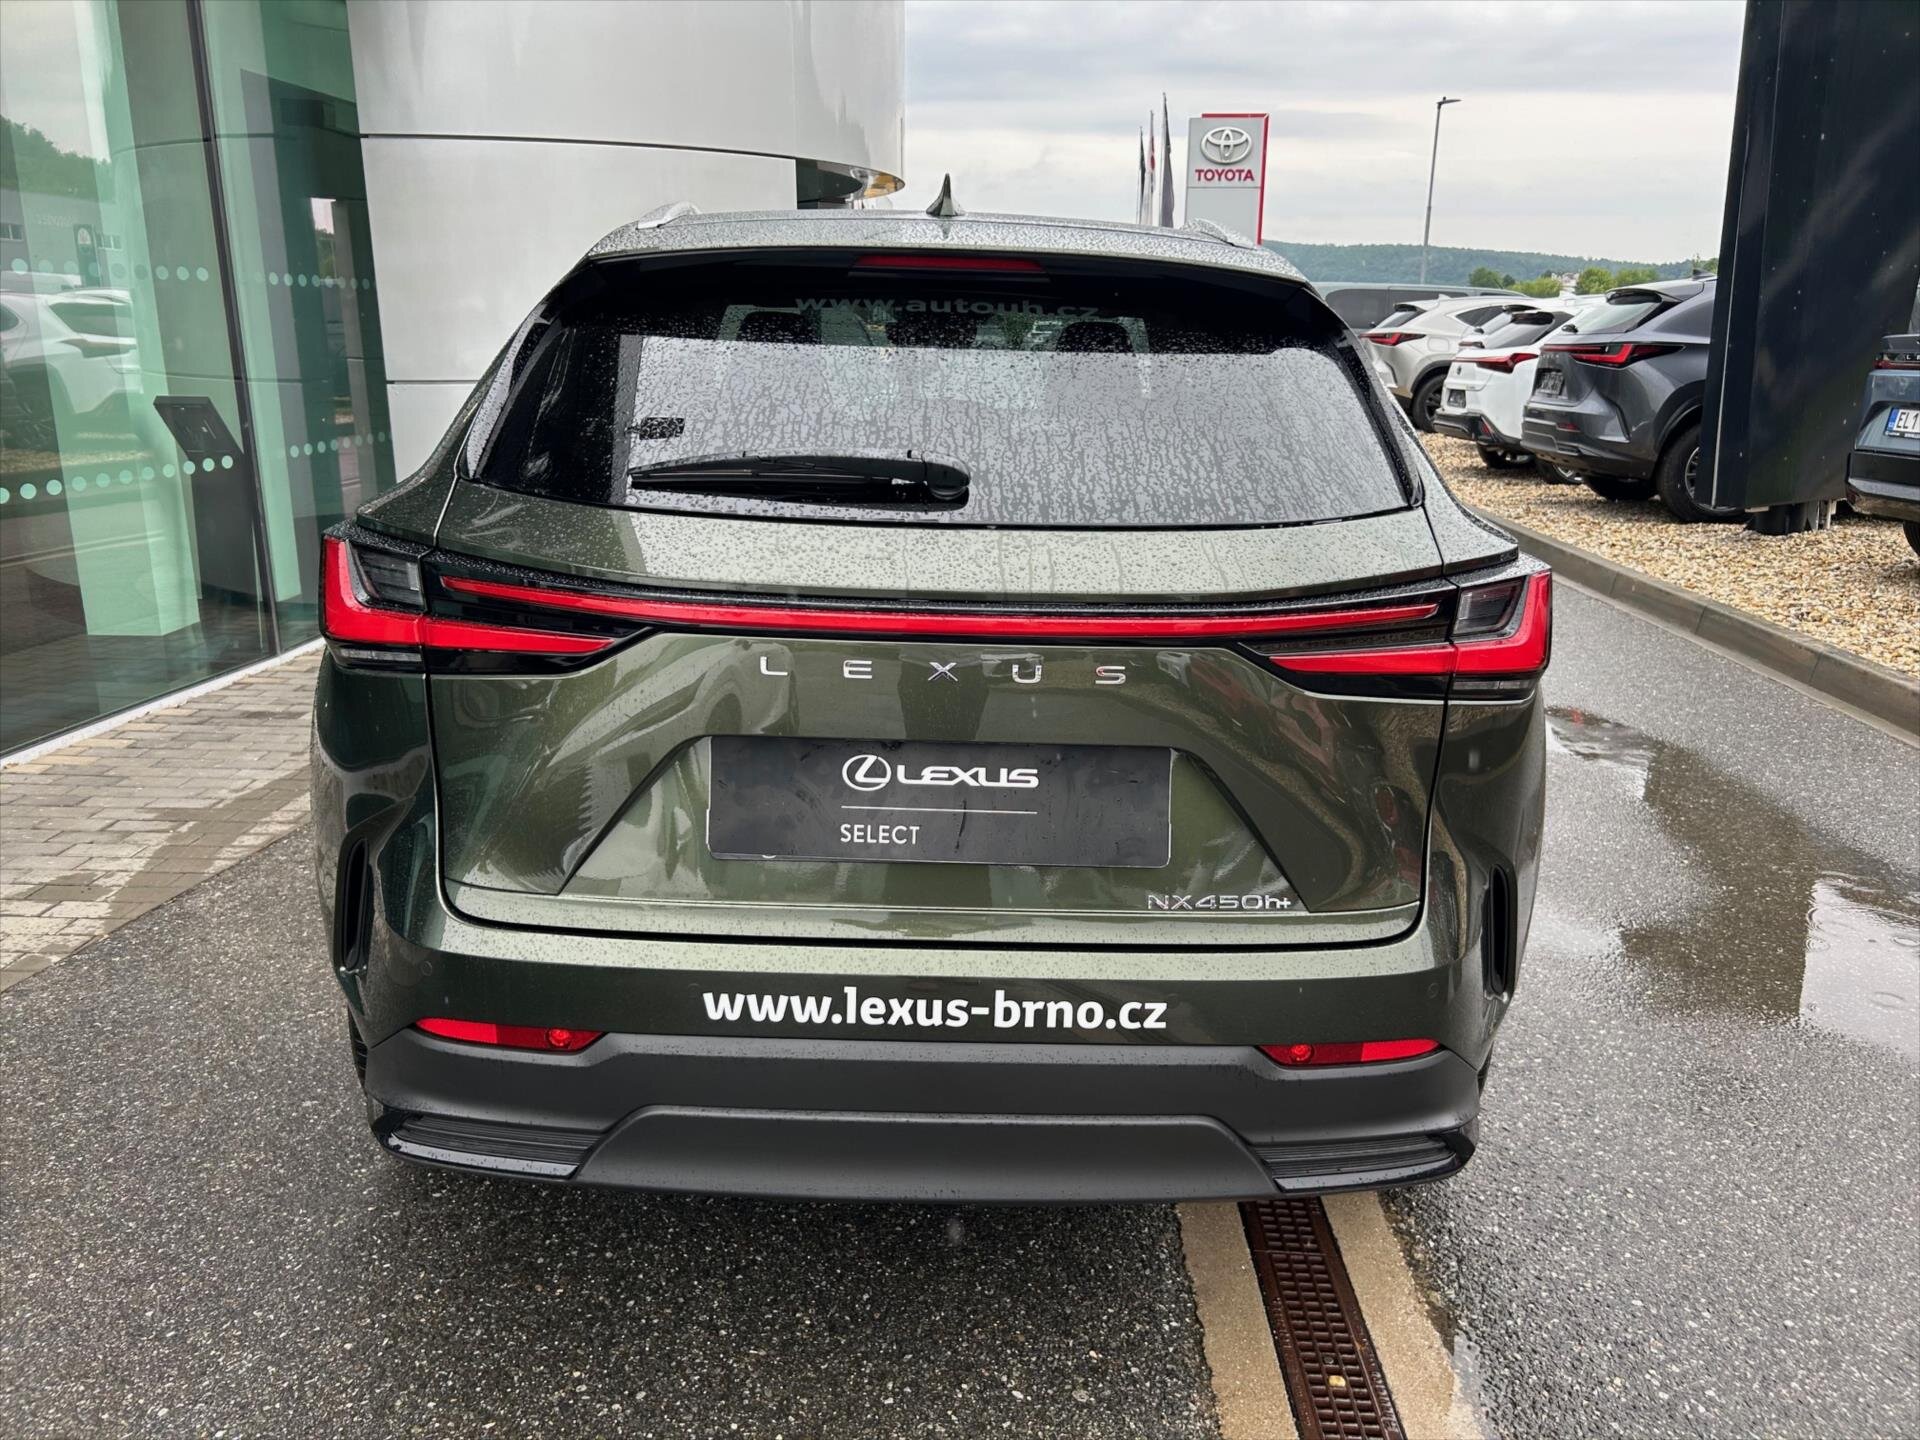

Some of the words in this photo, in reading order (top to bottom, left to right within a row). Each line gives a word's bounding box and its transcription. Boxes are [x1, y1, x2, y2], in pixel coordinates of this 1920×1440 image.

[1195, 169, 1254, 181] TOYOTA
[795, 298, 1100, 320] www.autouh.cz
[760, 656, 1126, 685] LEXUS
[897, 764, 1039, 789] LEXUS
[840, 823, 920, 845] SELECT
[703, 986, 1168, 1030] www.lexus-brno.cz
